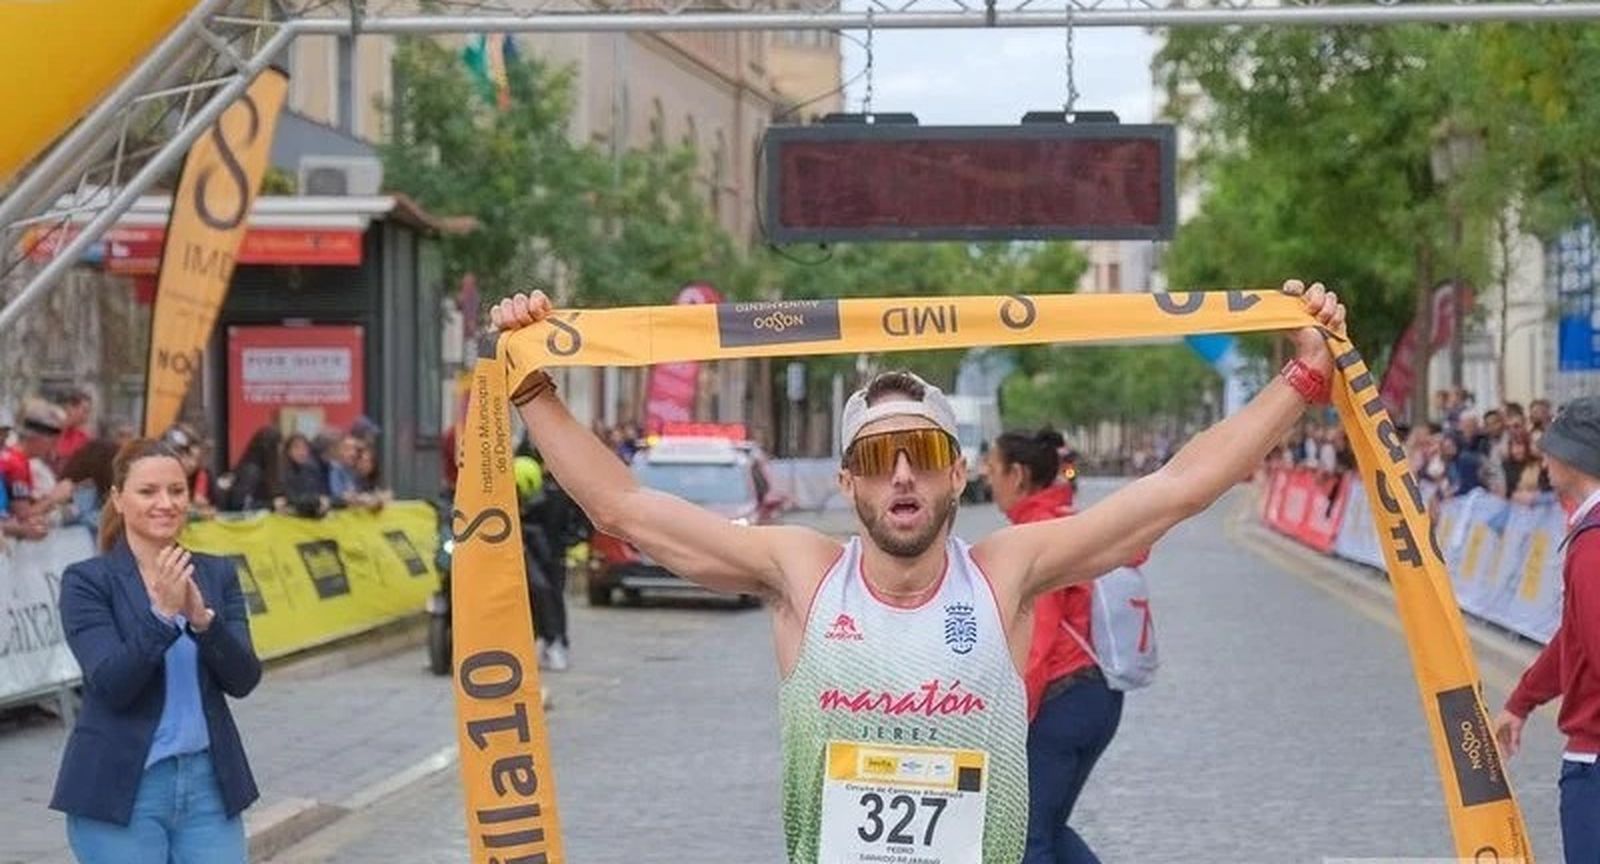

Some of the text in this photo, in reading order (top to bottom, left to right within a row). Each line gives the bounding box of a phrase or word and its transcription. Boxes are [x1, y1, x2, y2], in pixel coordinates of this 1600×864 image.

[882, 304, 959, 337] IMD
[476, 375, 493, 494] Instituto Municipal
[492, 396, 507, 474] de Deportes
[819, 679, 986, 716] maratón
[857, 792, 948, 847] 327
